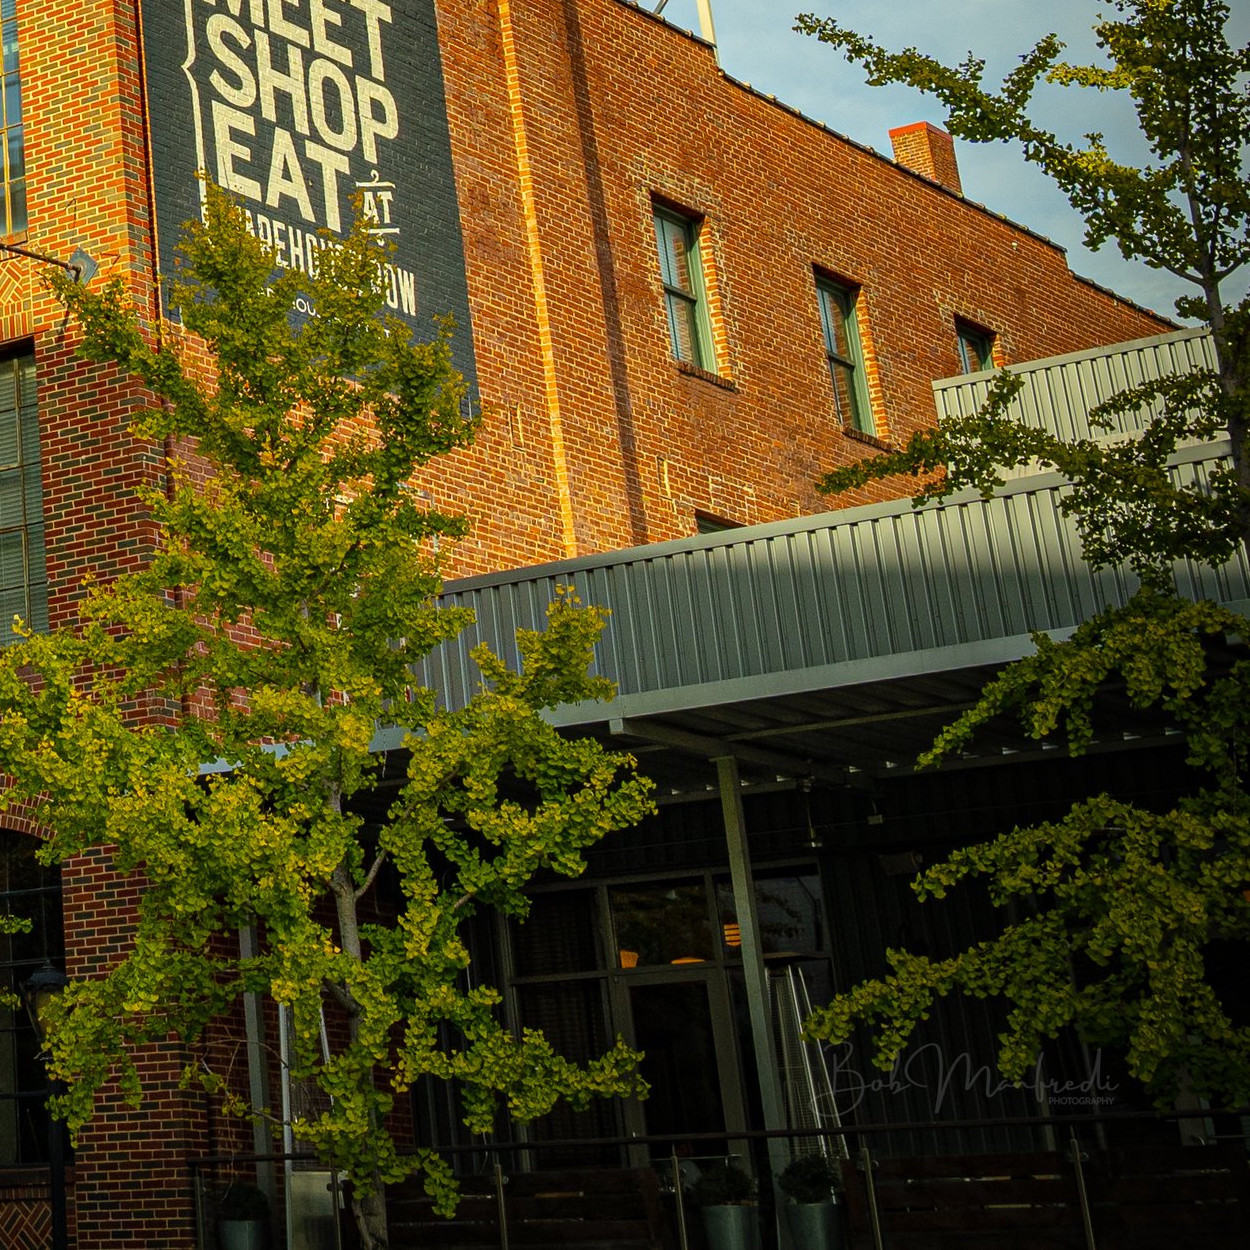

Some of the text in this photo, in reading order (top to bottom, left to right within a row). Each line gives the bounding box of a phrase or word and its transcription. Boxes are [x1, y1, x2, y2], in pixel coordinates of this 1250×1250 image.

[206, 13, 399, 165] SHOP
[210, 98, 351, 234] EAT
[362, 190, 394, 225] AT
